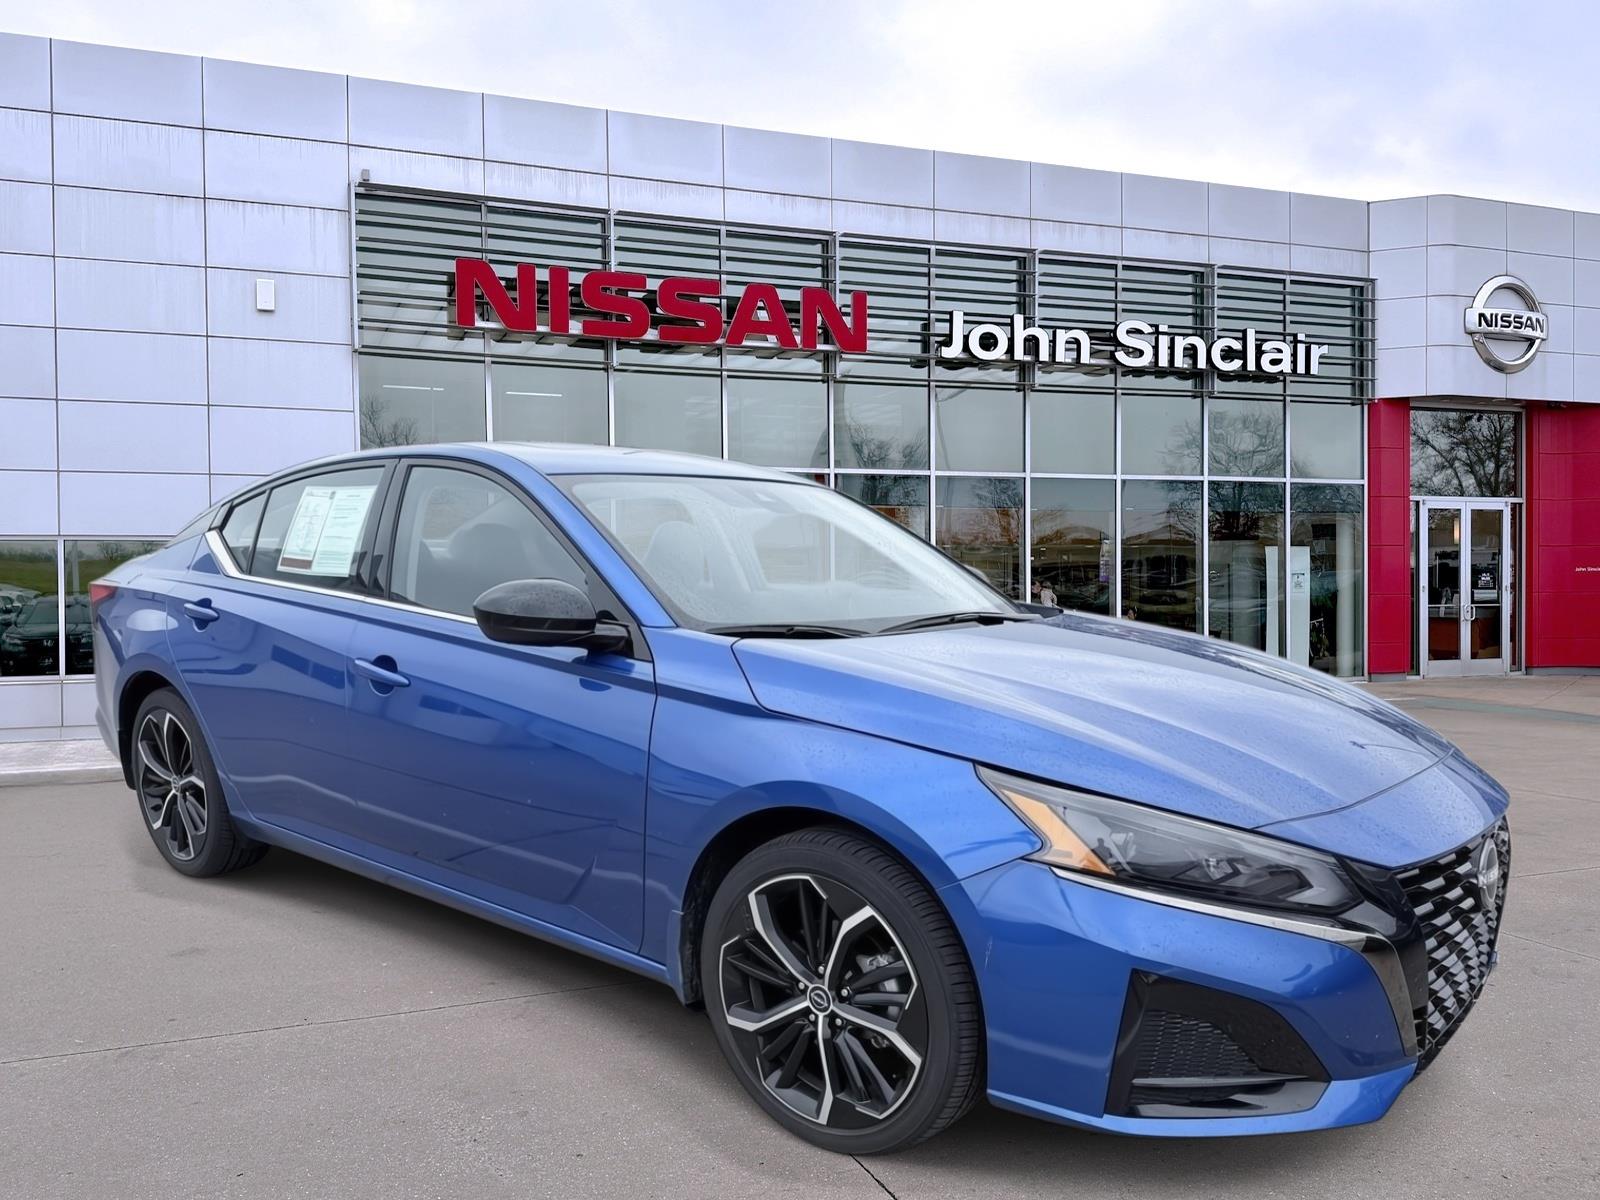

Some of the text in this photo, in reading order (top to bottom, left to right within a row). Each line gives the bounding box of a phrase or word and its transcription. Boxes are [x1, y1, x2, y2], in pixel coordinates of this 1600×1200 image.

[454, 257, 868, 354] NISSAN
[1477, 312, 1545, 333] NISSAN
[940, 310, 1329, 375] John Sinclair
